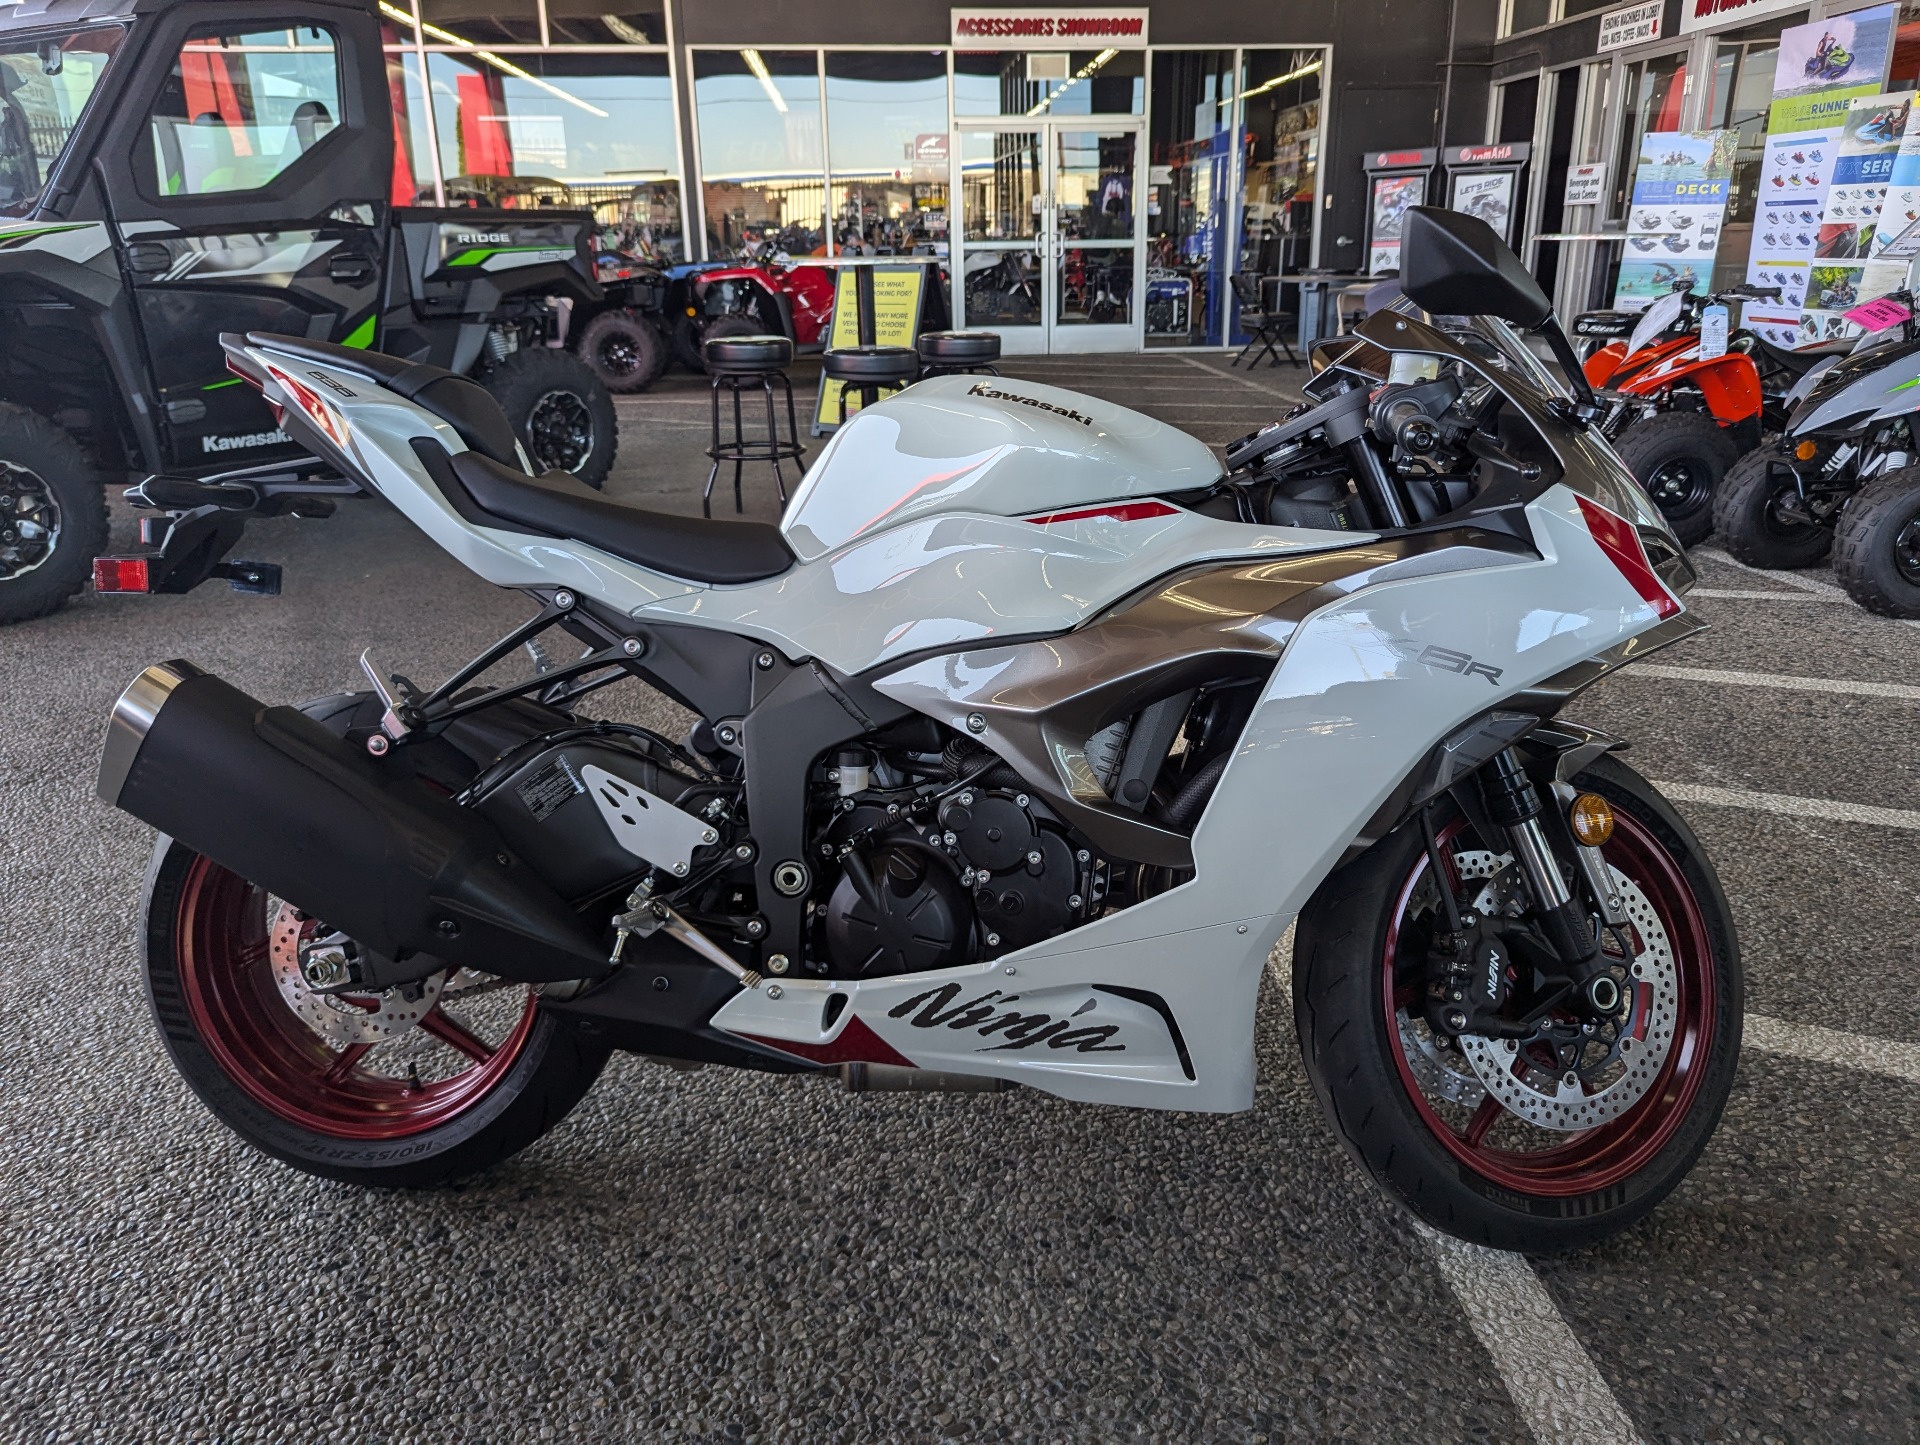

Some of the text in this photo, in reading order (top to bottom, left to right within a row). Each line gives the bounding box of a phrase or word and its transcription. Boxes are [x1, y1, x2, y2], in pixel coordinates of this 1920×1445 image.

[956, 17, 1143, 36] ACCESSORIES SHOWROOM
[1603, 4, 1660, 31] VENDING MACHINES IN LOBBY
[1623, 27, 1634, 42] COFFEE
[1781, 98, 1851, 119] WAVERUNNE
[1861, 160, 1892, 174] SER
[1459, 177, 1504, 196] LET'S RIDE
[1569, 176, 1600, 188] Beverage and
[1568, 189, 1598, 200] Snack Center
[925, 214, 945, 223] EBC
[457, 232, 511, 244] RIDGE
[307, 371, 358, 398] 636
[966, 384, 1094, 426] Kawasaki
[887, 982, 1126, 1052] Ninja
